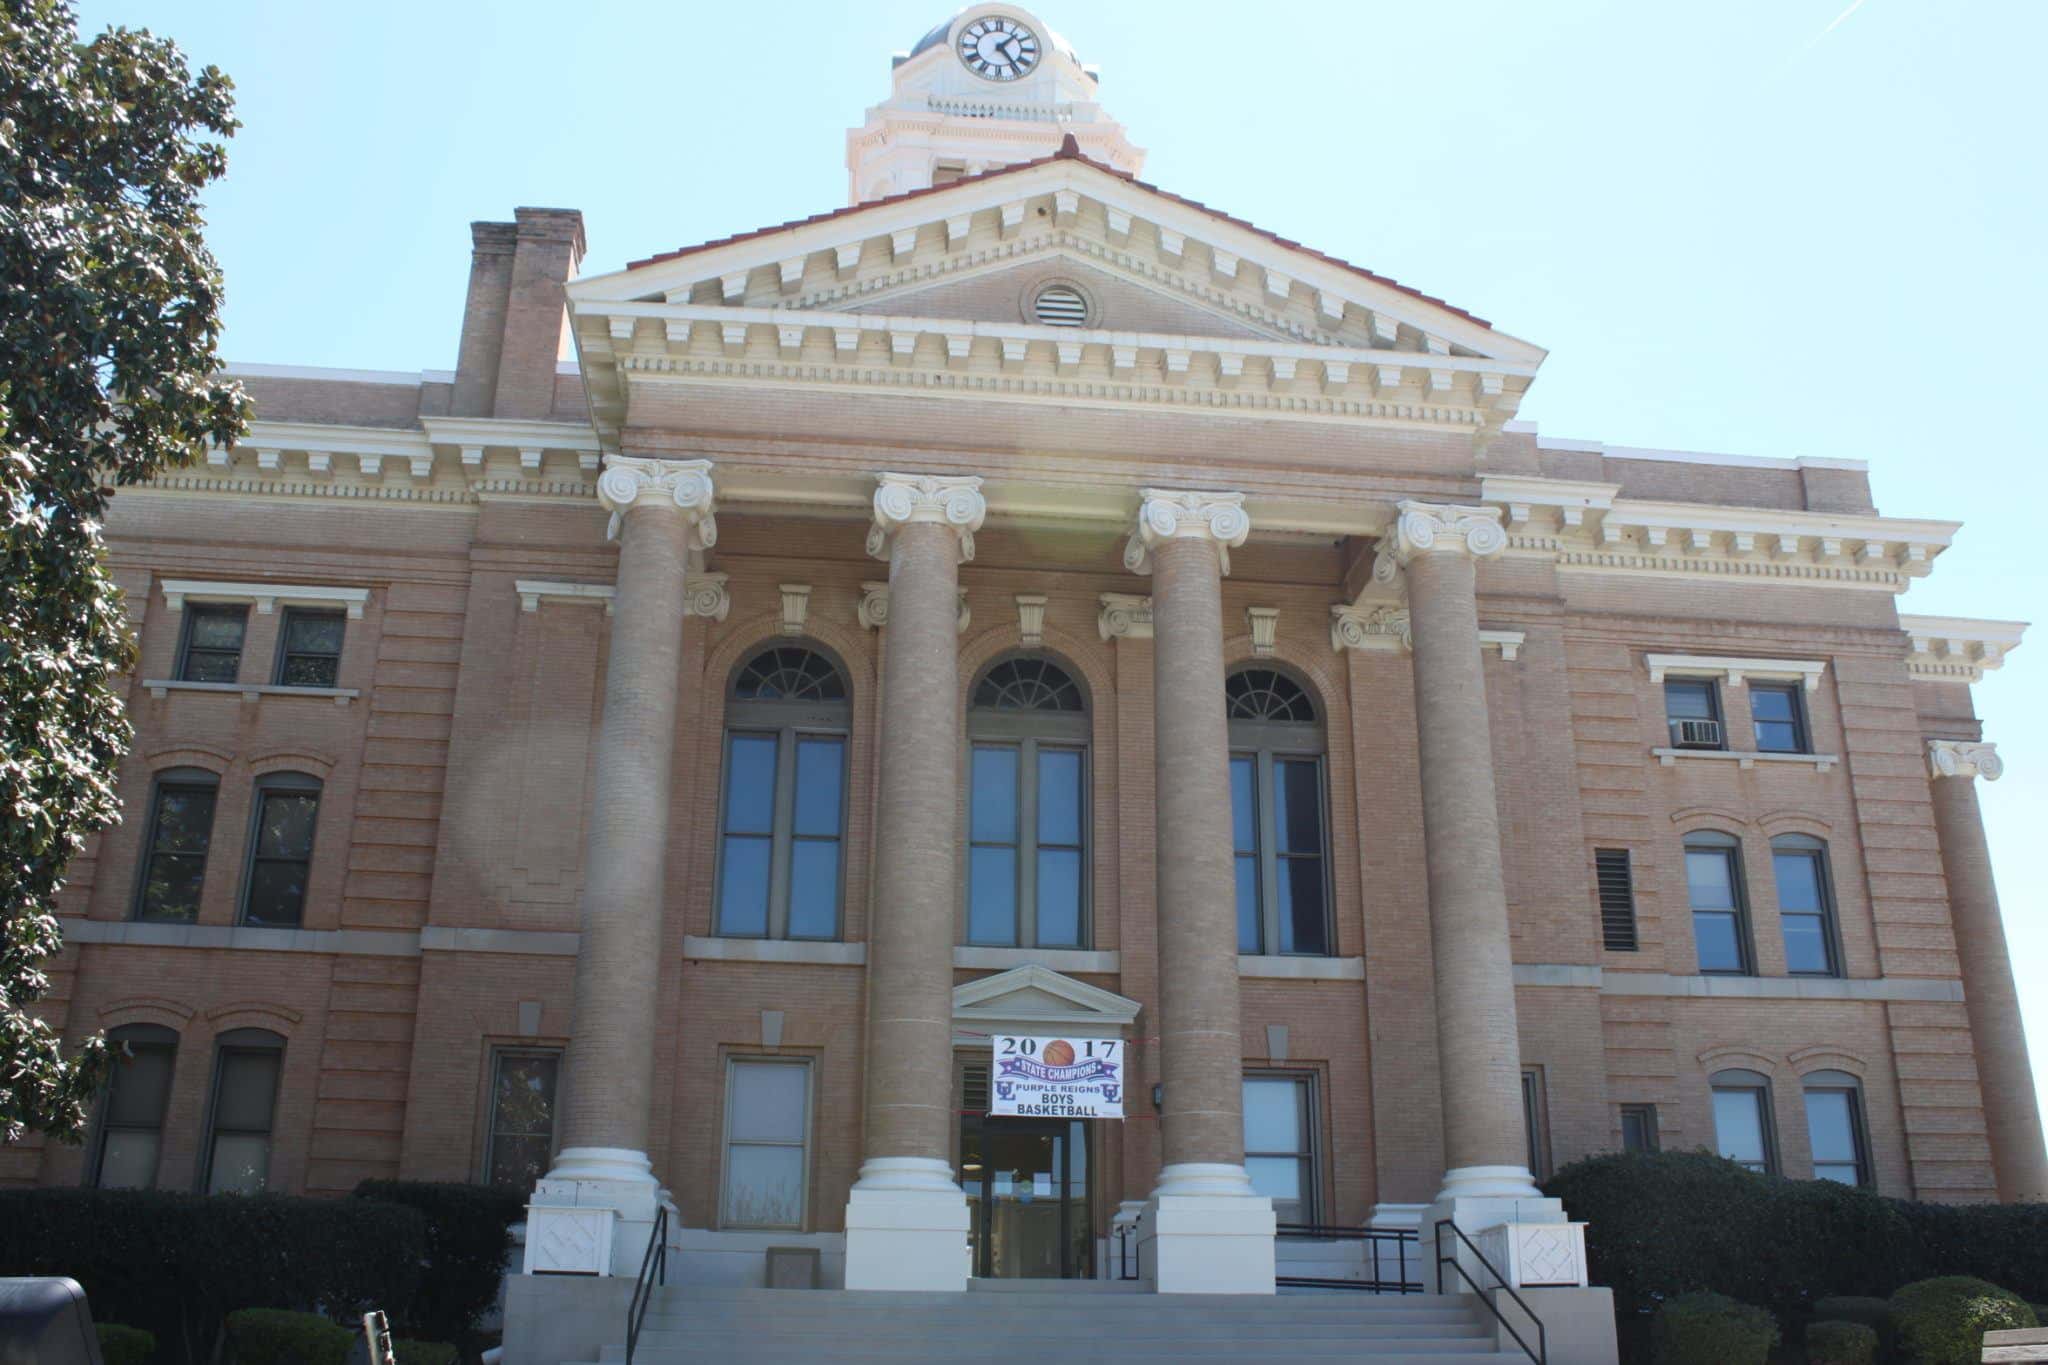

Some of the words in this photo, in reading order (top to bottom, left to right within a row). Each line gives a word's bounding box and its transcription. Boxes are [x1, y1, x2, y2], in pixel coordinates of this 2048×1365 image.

[1001, 1038, 1036, 1055] 20
[1085, 1040, 1116, 1058] 17
[1021, 1061, 1046, 1078] STATE
[1048, 1062, 1096, 1080] CHAMPIONS
[1016, 1083, 1057, 1092] PURPLE
[1060, 1085, 1100, 1094] REIGNS
[1042, 1093, 1074, 1104] BOYS
[1017, 1104, 1098, 1117] BASKETBALL
